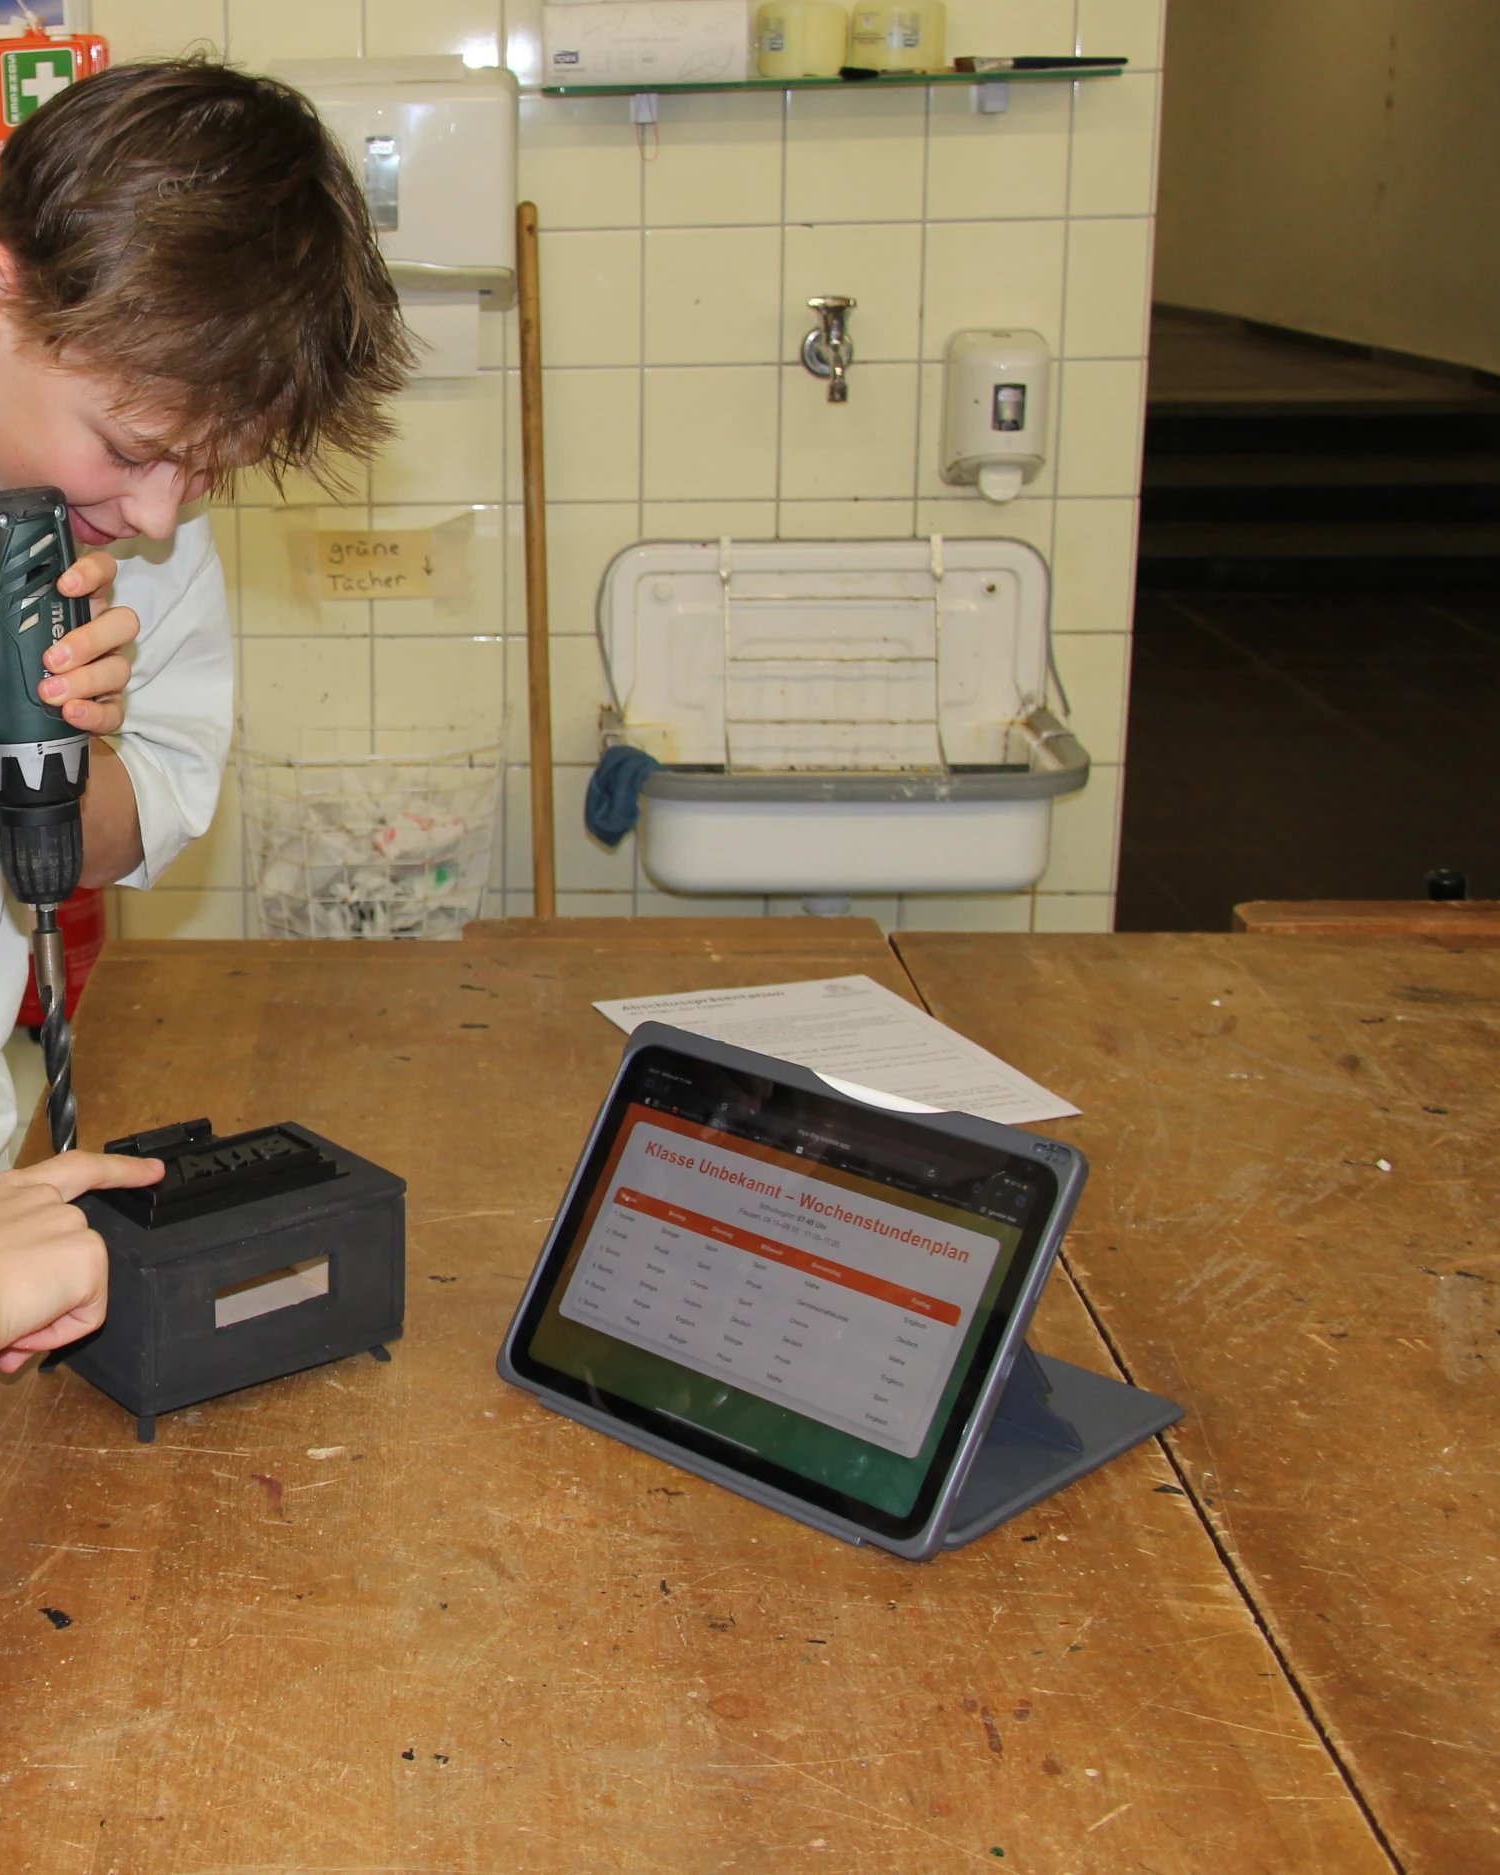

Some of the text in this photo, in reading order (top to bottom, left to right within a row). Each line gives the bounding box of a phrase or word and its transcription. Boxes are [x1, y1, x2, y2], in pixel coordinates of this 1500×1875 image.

[328, 540, 400, 564] grüne
[327, 570, 406, 591] Tücher
[622, 990, 785, 1012] Abschlusspräsentation
[645, 1140, 697, 1169] Klasse
[698, 1158, 783, 1199] Unbekannt
[797, 1192, 971, 1266] Wochenstundenplan
[814, 1220, 827, 1231] Uhr
